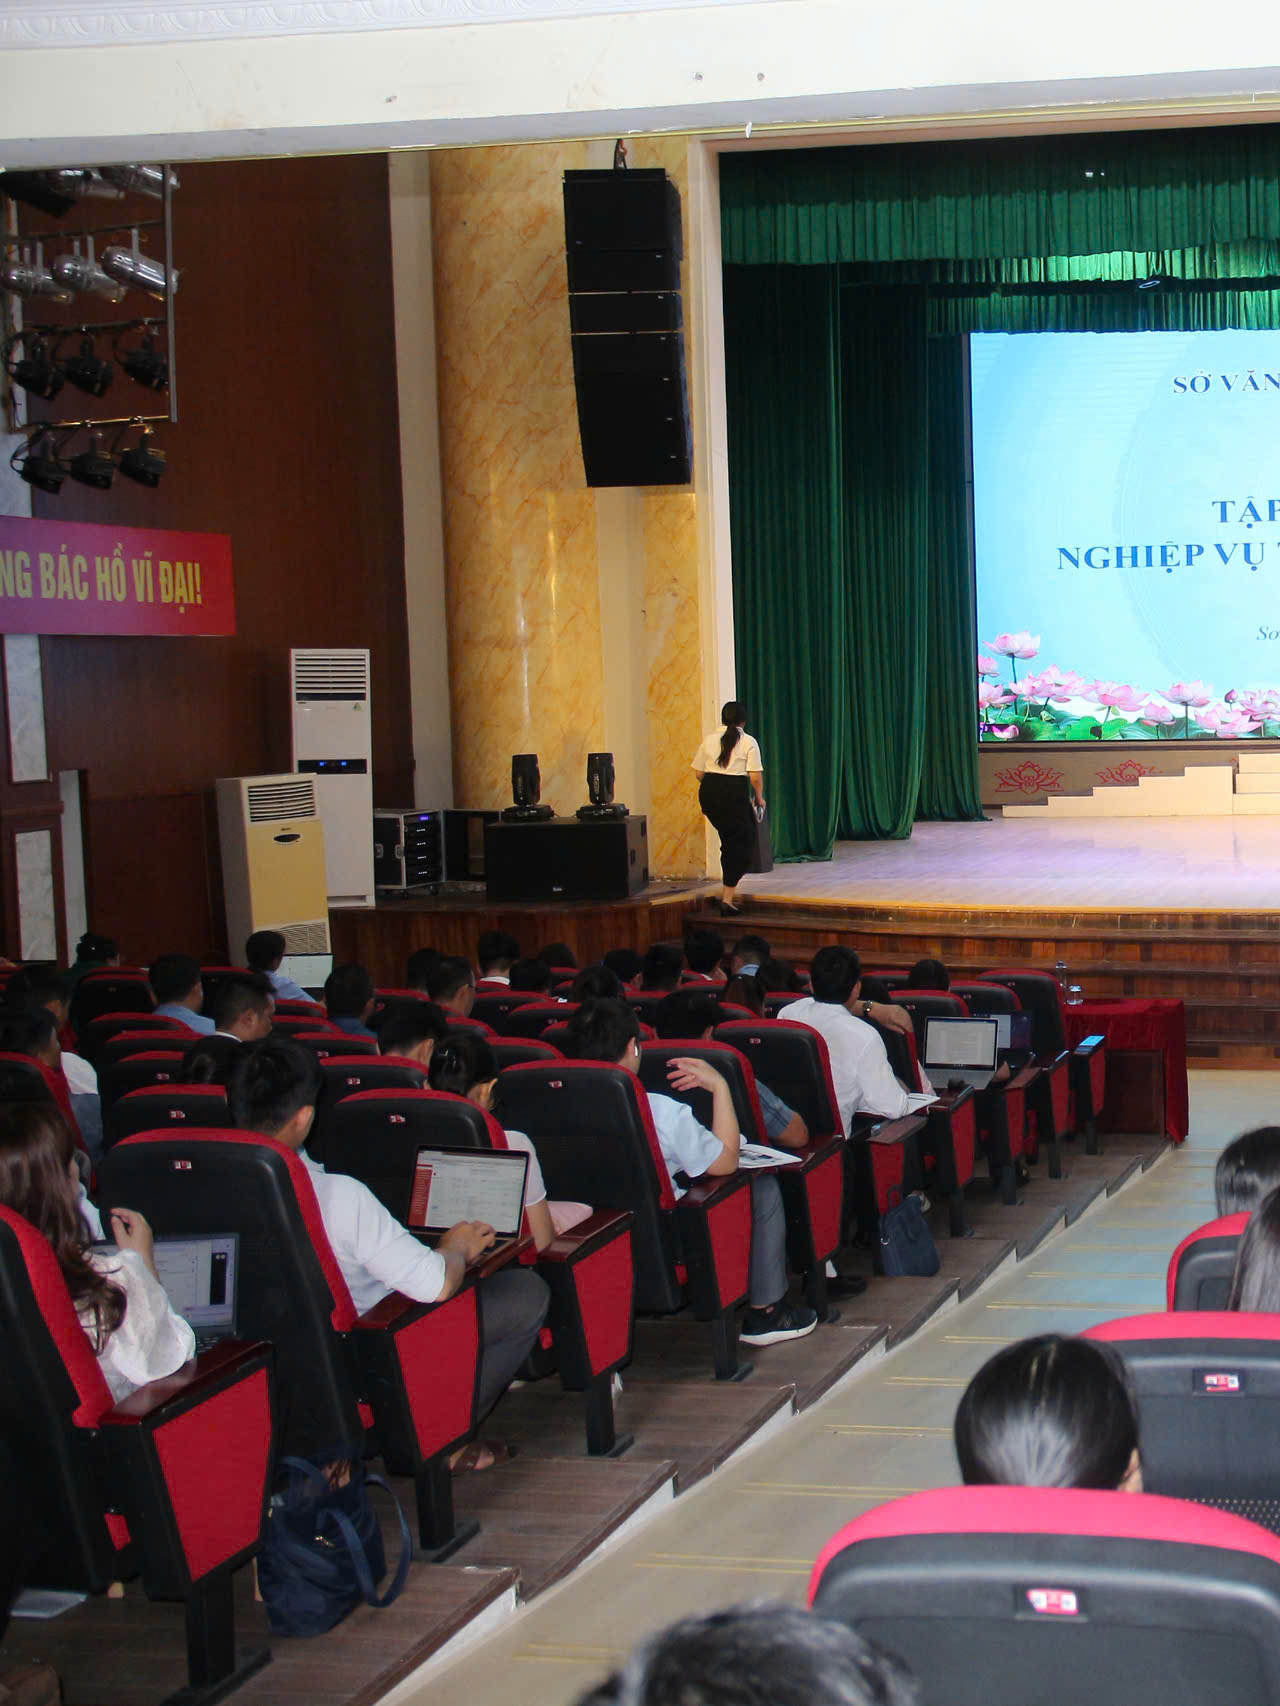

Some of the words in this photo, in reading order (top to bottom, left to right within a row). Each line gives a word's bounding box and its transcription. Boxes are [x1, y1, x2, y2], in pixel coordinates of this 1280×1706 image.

[1173, 369, 1212, 394] SỞ
[1220, 369, 1280, 392] VĂN
[1055, 541, 1206, 574] NGHIỆP
[1213, 542, 1266, 572] VỤ
[39, 543, 89, 600] BÁC
[95, 542, 128, 602] HỒ
[132, 551, 154, 603] VĨ
[159, 560, 203, 614] ĐẠI!
